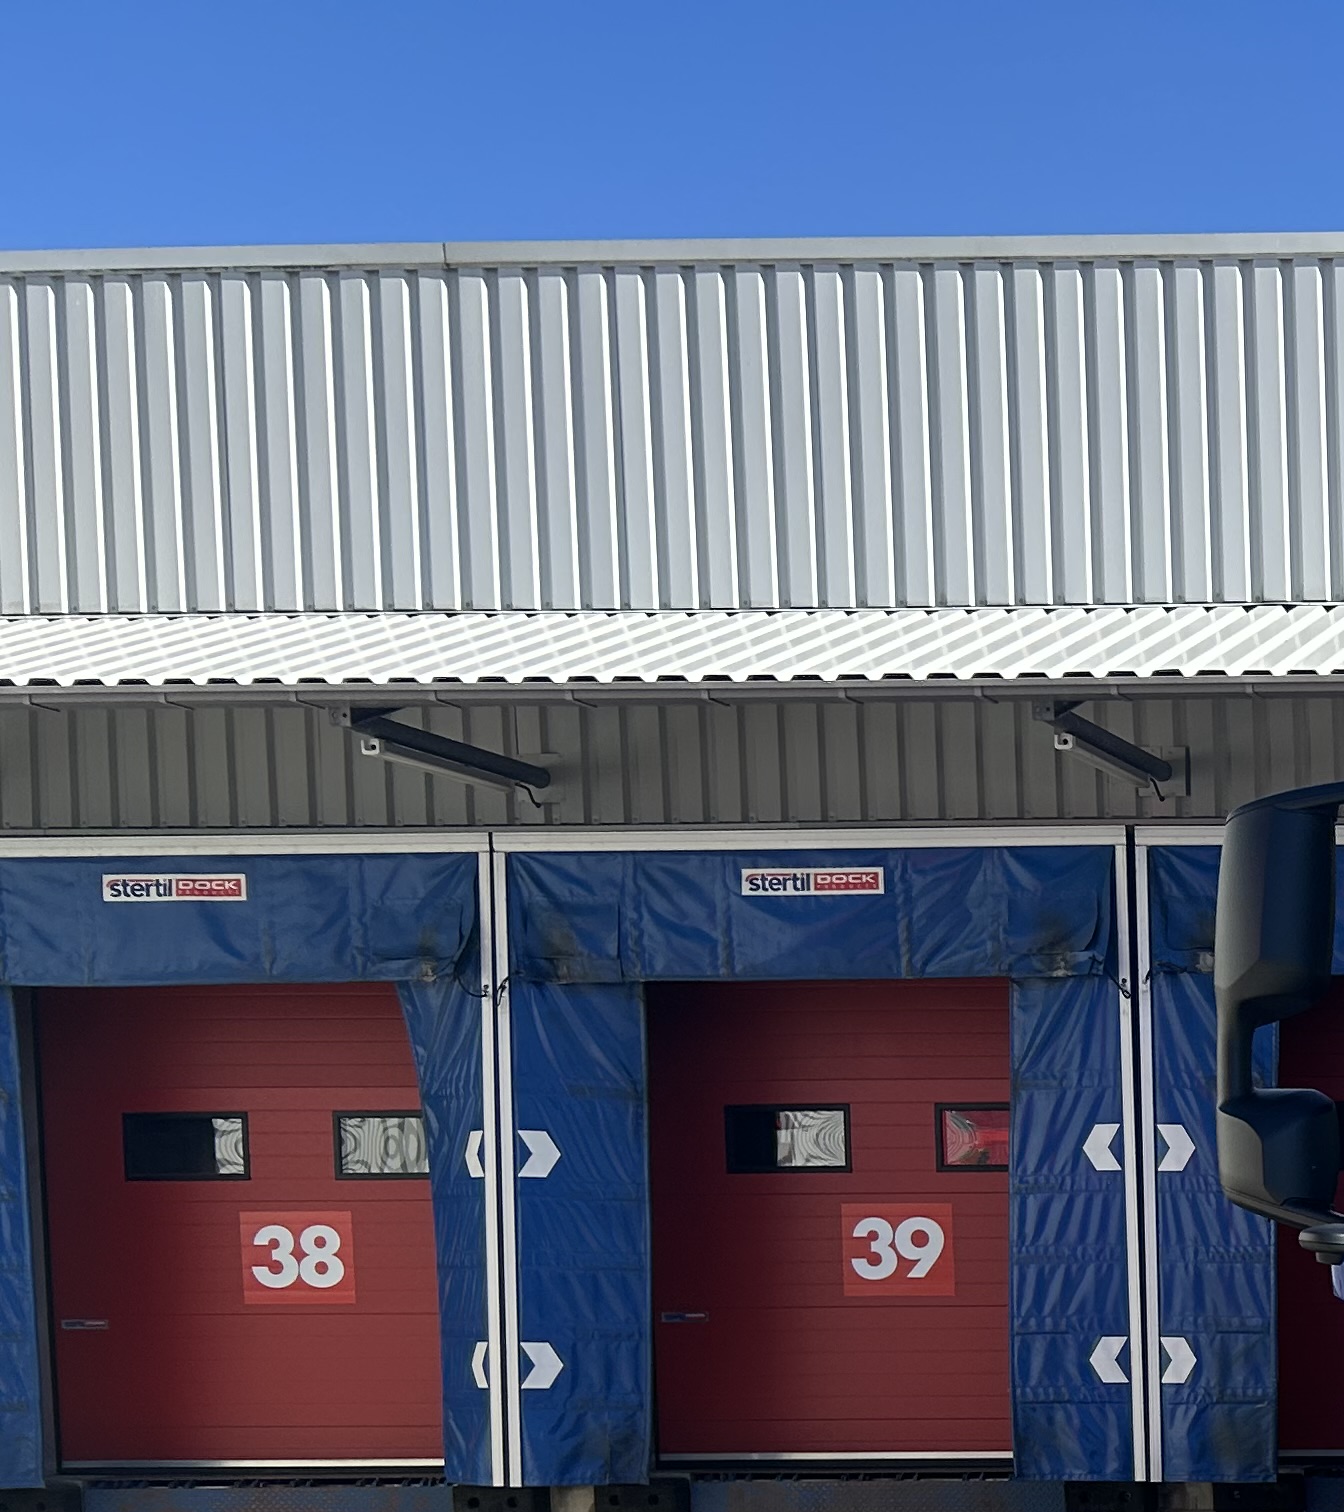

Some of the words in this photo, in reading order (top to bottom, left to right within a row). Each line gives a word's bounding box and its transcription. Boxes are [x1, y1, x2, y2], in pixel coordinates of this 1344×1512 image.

[109, 879, 173, 898] stertil
[178, 880, 239, 890] DOCK
[748, 873, 811, 892] stertil
[816, 874, 876, 884] DOCK
[252, 1224, 345, 1289] 38
[851, 1216, 945, 1280] 39
